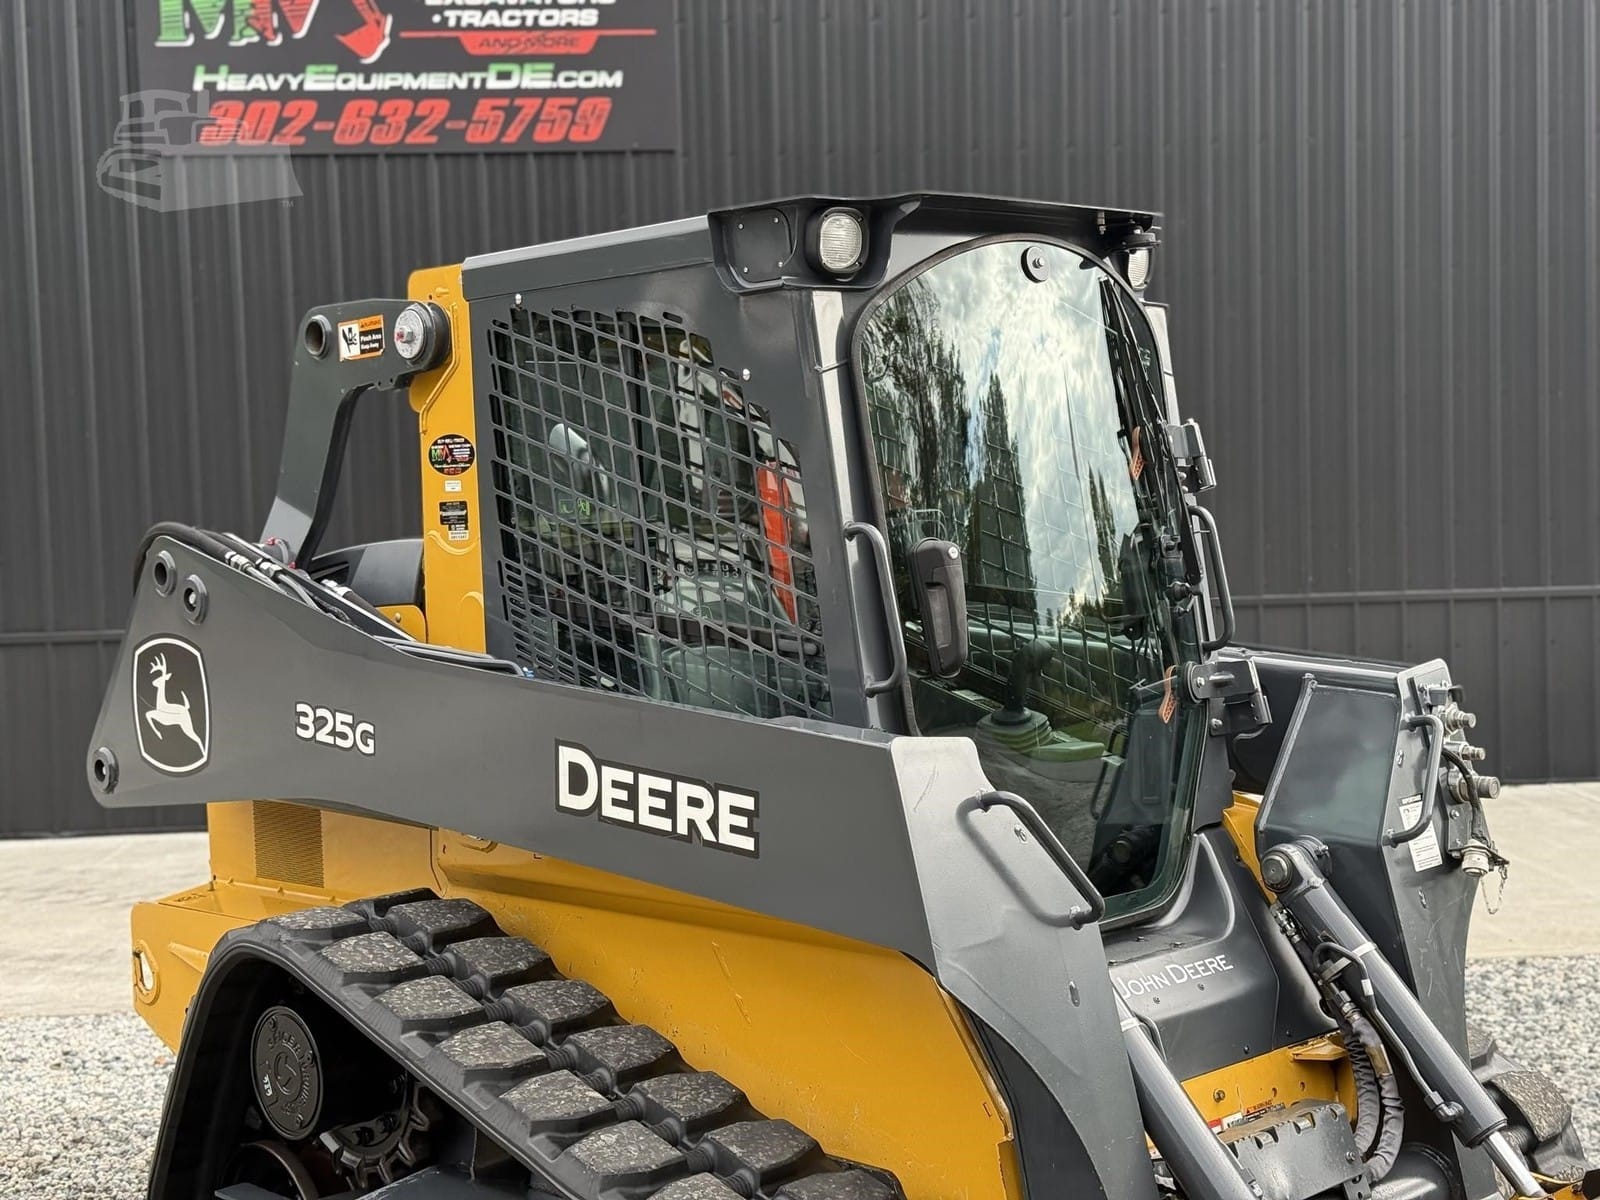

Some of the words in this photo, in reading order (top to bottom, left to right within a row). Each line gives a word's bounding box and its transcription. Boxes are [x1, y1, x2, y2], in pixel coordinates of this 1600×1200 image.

[443, 9, 599, 28] TRACTORS
[479, 37, 519, 49] AND
[199, 96, 613, 146] 302-632-5759
[296, 703, 375, 754] 325G
[558, 745, 755, 851] DEERE
[1115, 975, 1172, 1000] JOHN
[1164, 954, 1234, 984] DEERE
